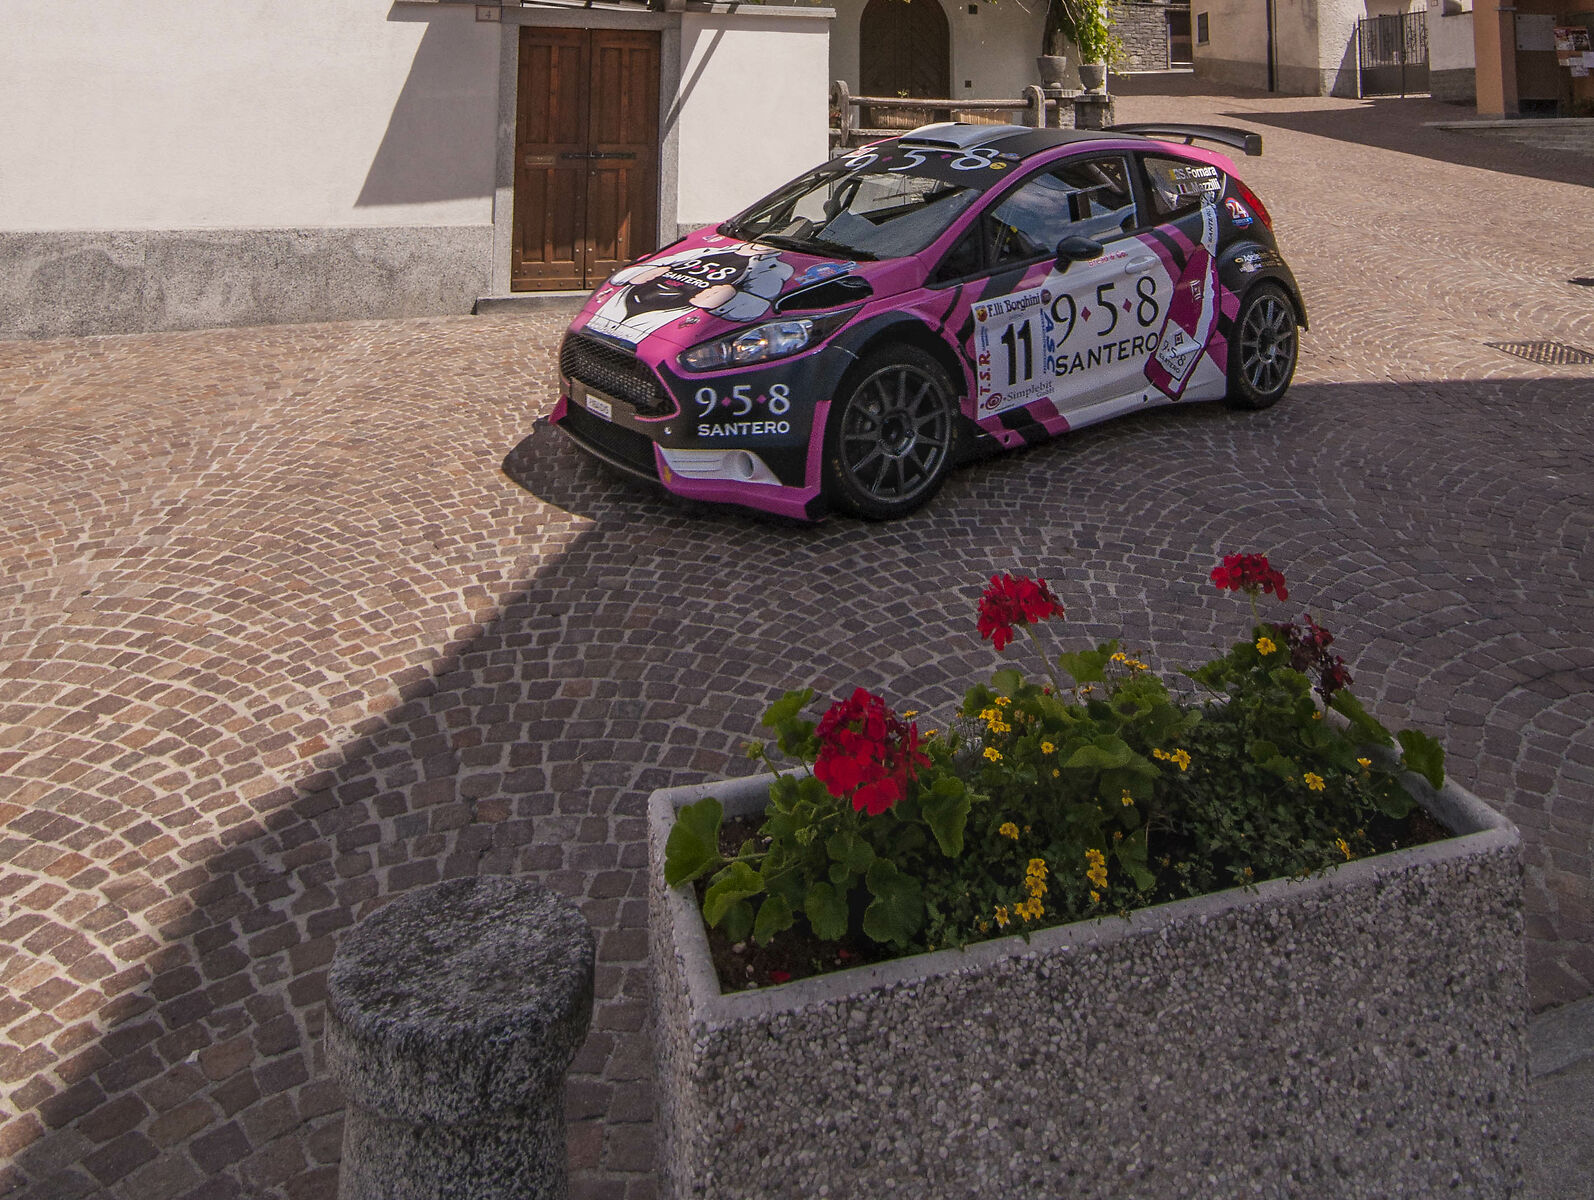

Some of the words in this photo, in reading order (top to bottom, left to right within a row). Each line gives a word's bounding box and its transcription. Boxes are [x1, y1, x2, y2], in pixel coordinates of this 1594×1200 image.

[1225, 201, 1249, 219] 24
[662, 271, 710, 288] SANTERO
[1004, 292, 1040, 313] Borghini
[1000, 319, 1033, 386] 11
[1055, 332, 1159, 377] SANTERO
[697, 421, 790, 437] SANTERO
